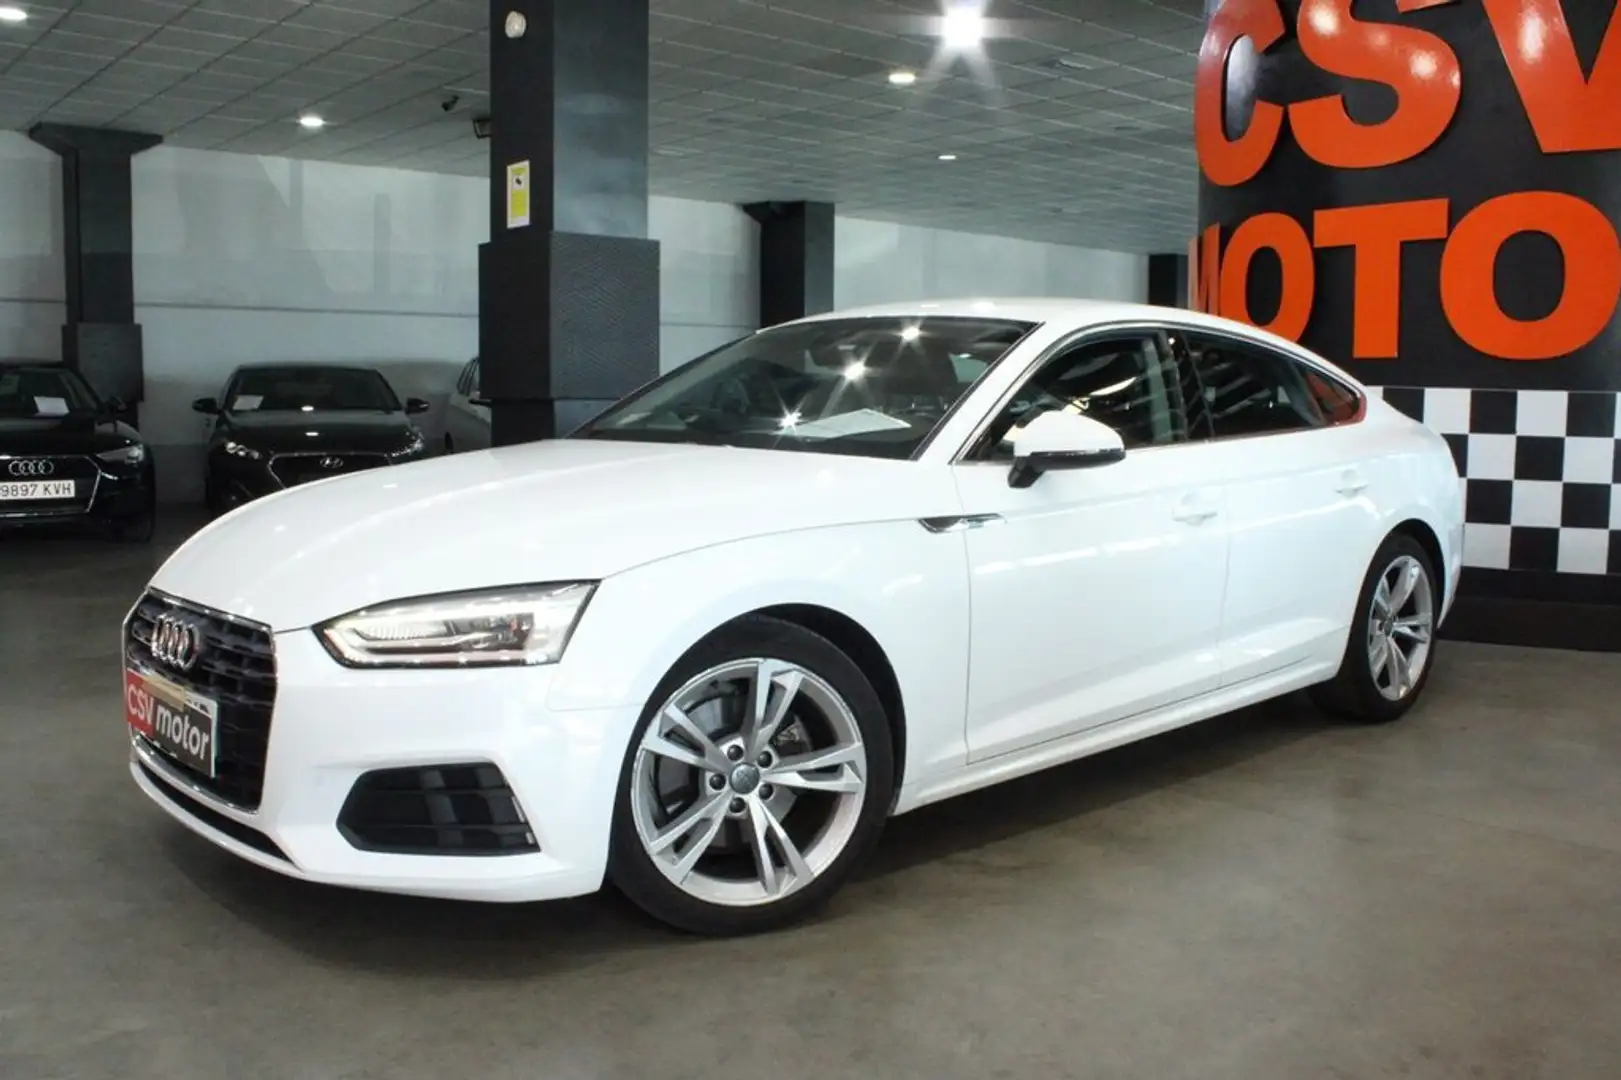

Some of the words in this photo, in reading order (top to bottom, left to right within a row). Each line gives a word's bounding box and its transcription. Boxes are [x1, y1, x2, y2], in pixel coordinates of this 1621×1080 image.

[1, 484, 38, 497] 9897
[43, 482, 71, 496] KVH
[127, 683, 155, 725] CSV
[155, 704, 210, 760] motor
